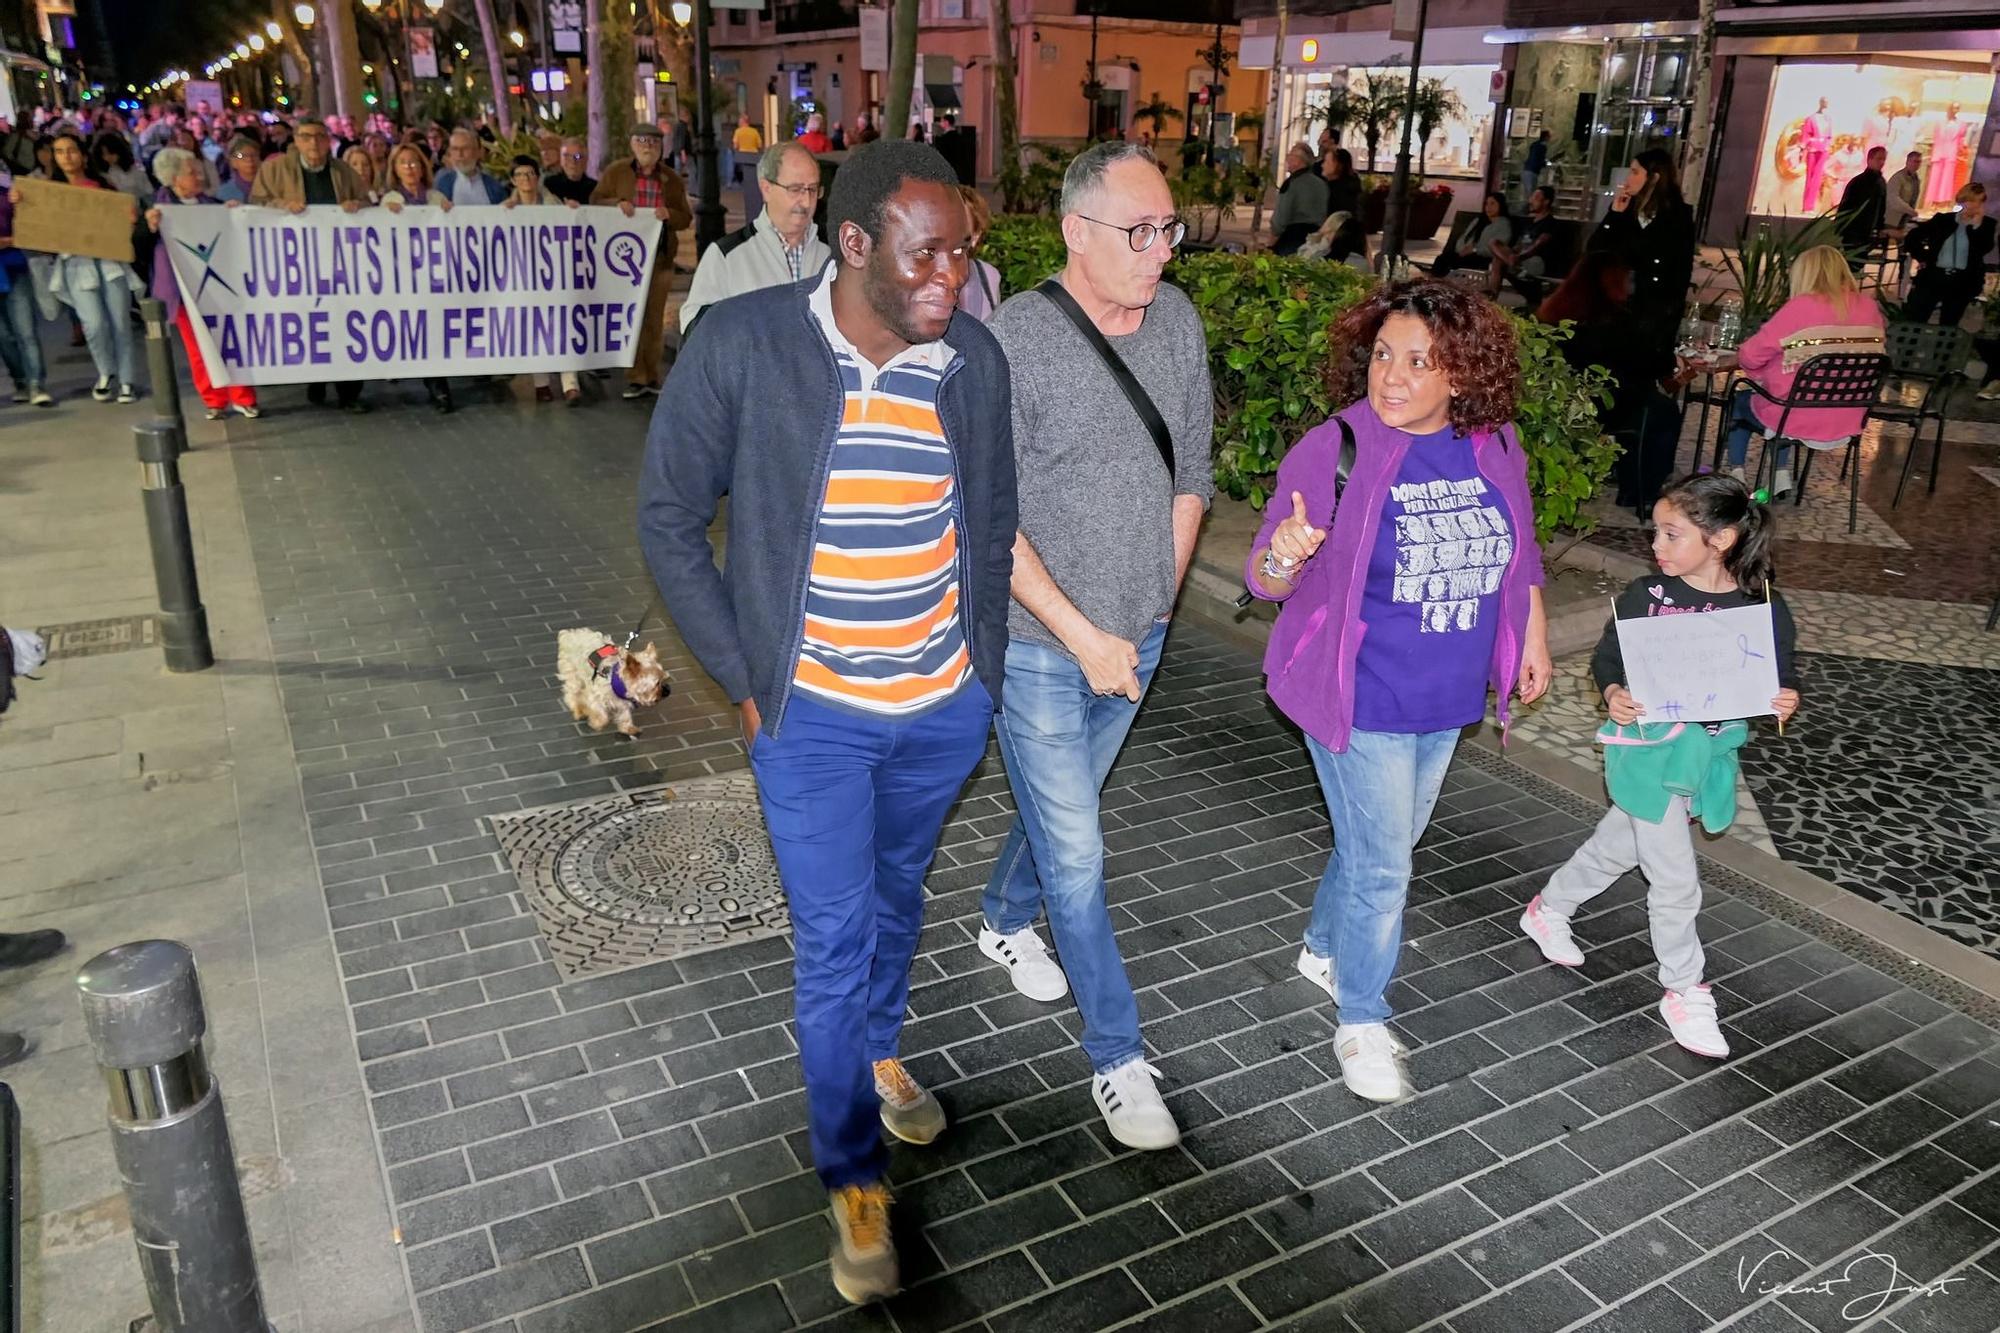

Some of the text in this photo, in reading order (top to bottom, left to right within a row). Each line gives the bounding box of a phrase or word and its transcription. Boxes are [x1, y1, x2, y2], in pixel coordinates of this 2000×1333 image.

[243, 225, 597, 298] JUBILATS I PENSIONISTES
[346, 309, 427, 363] SOM
